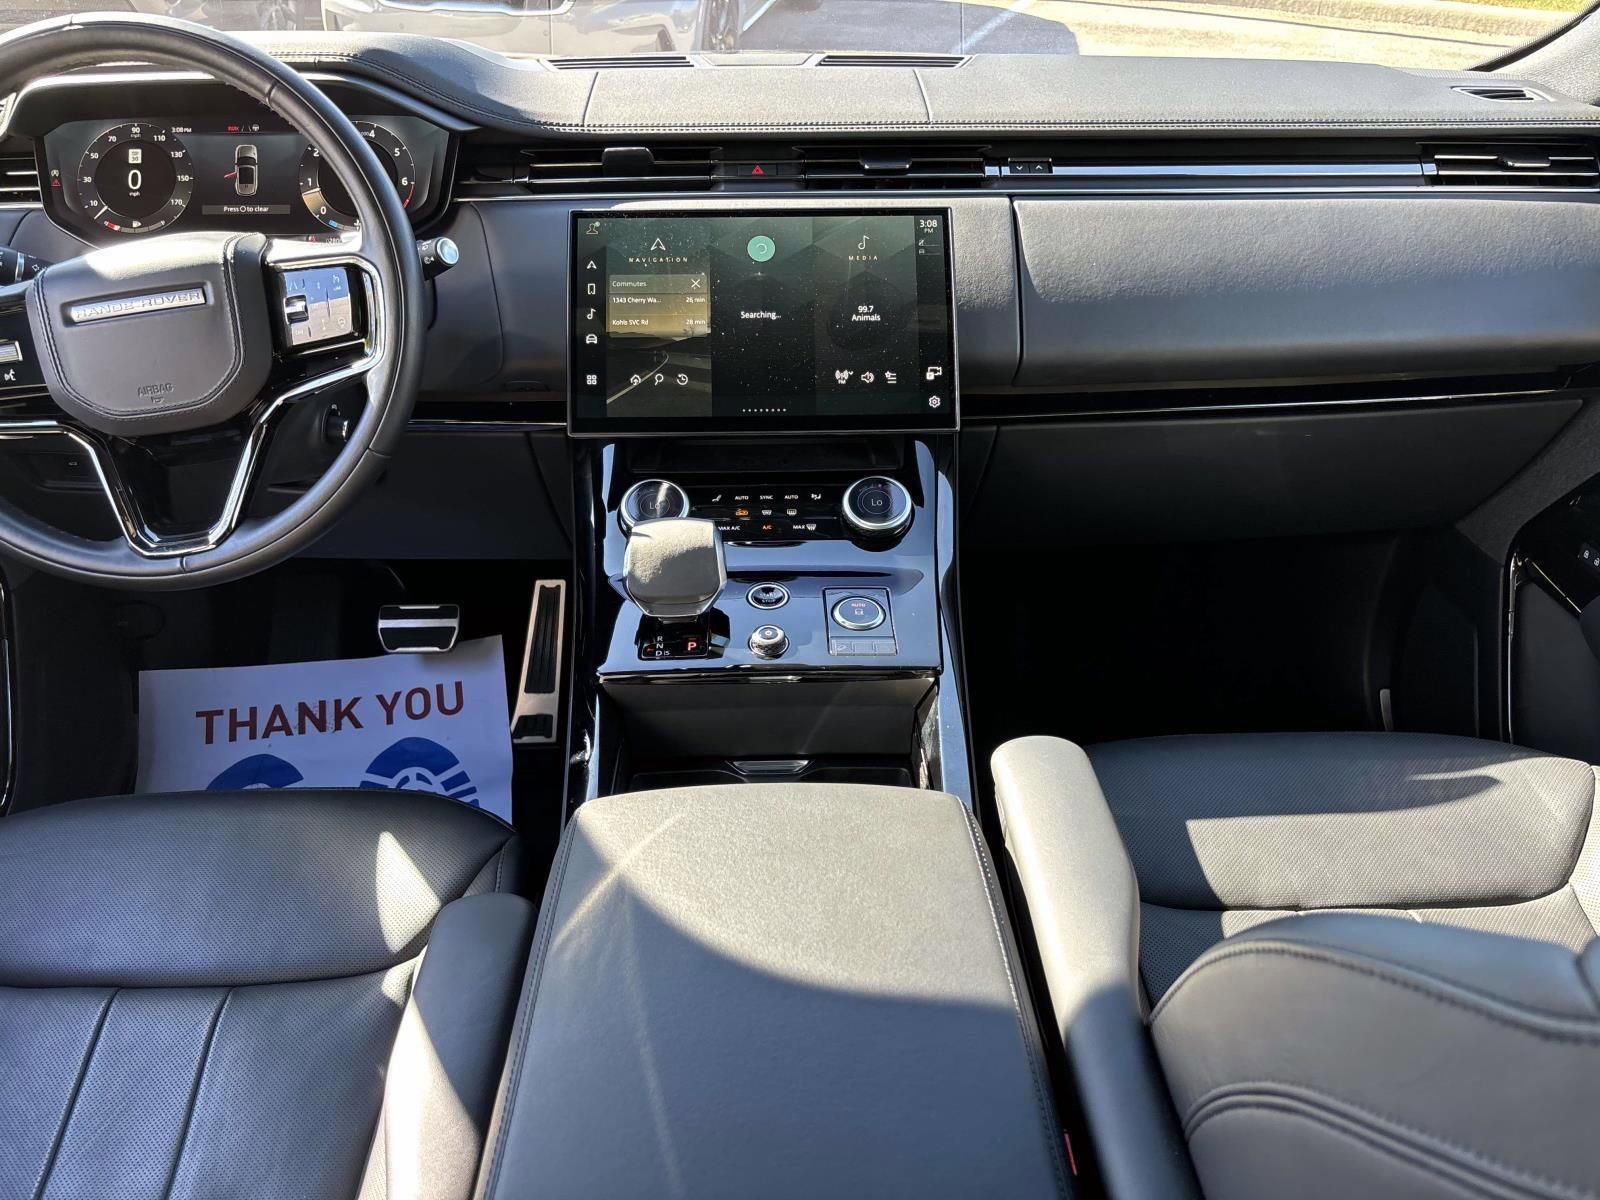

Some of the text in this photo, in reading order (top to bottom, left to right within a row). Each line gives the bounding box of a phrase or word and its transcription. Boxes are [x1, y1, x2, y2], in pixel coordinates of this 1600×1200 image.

[369, 129, 376, 138] 4
[313, 147, 320, 157] 2
[394, 147, 400, 157] 5
[127, 169, 142, 190] 0
[307, 177, 312, 187] 1
[401, 177, 408, 186] 6
[320, 206, 327, 215] 0
[919, 219, 938, 228] 3:08
[857, 305, 874, 313] 99.7
[851, 313, 881, 321] Animals
[137, 382, 175, 397] AIRBAG
[871, 498, 883, 506] Lo
[687, 641, 697, 651] P
[195, 680, 464, 745] THANK YOU
